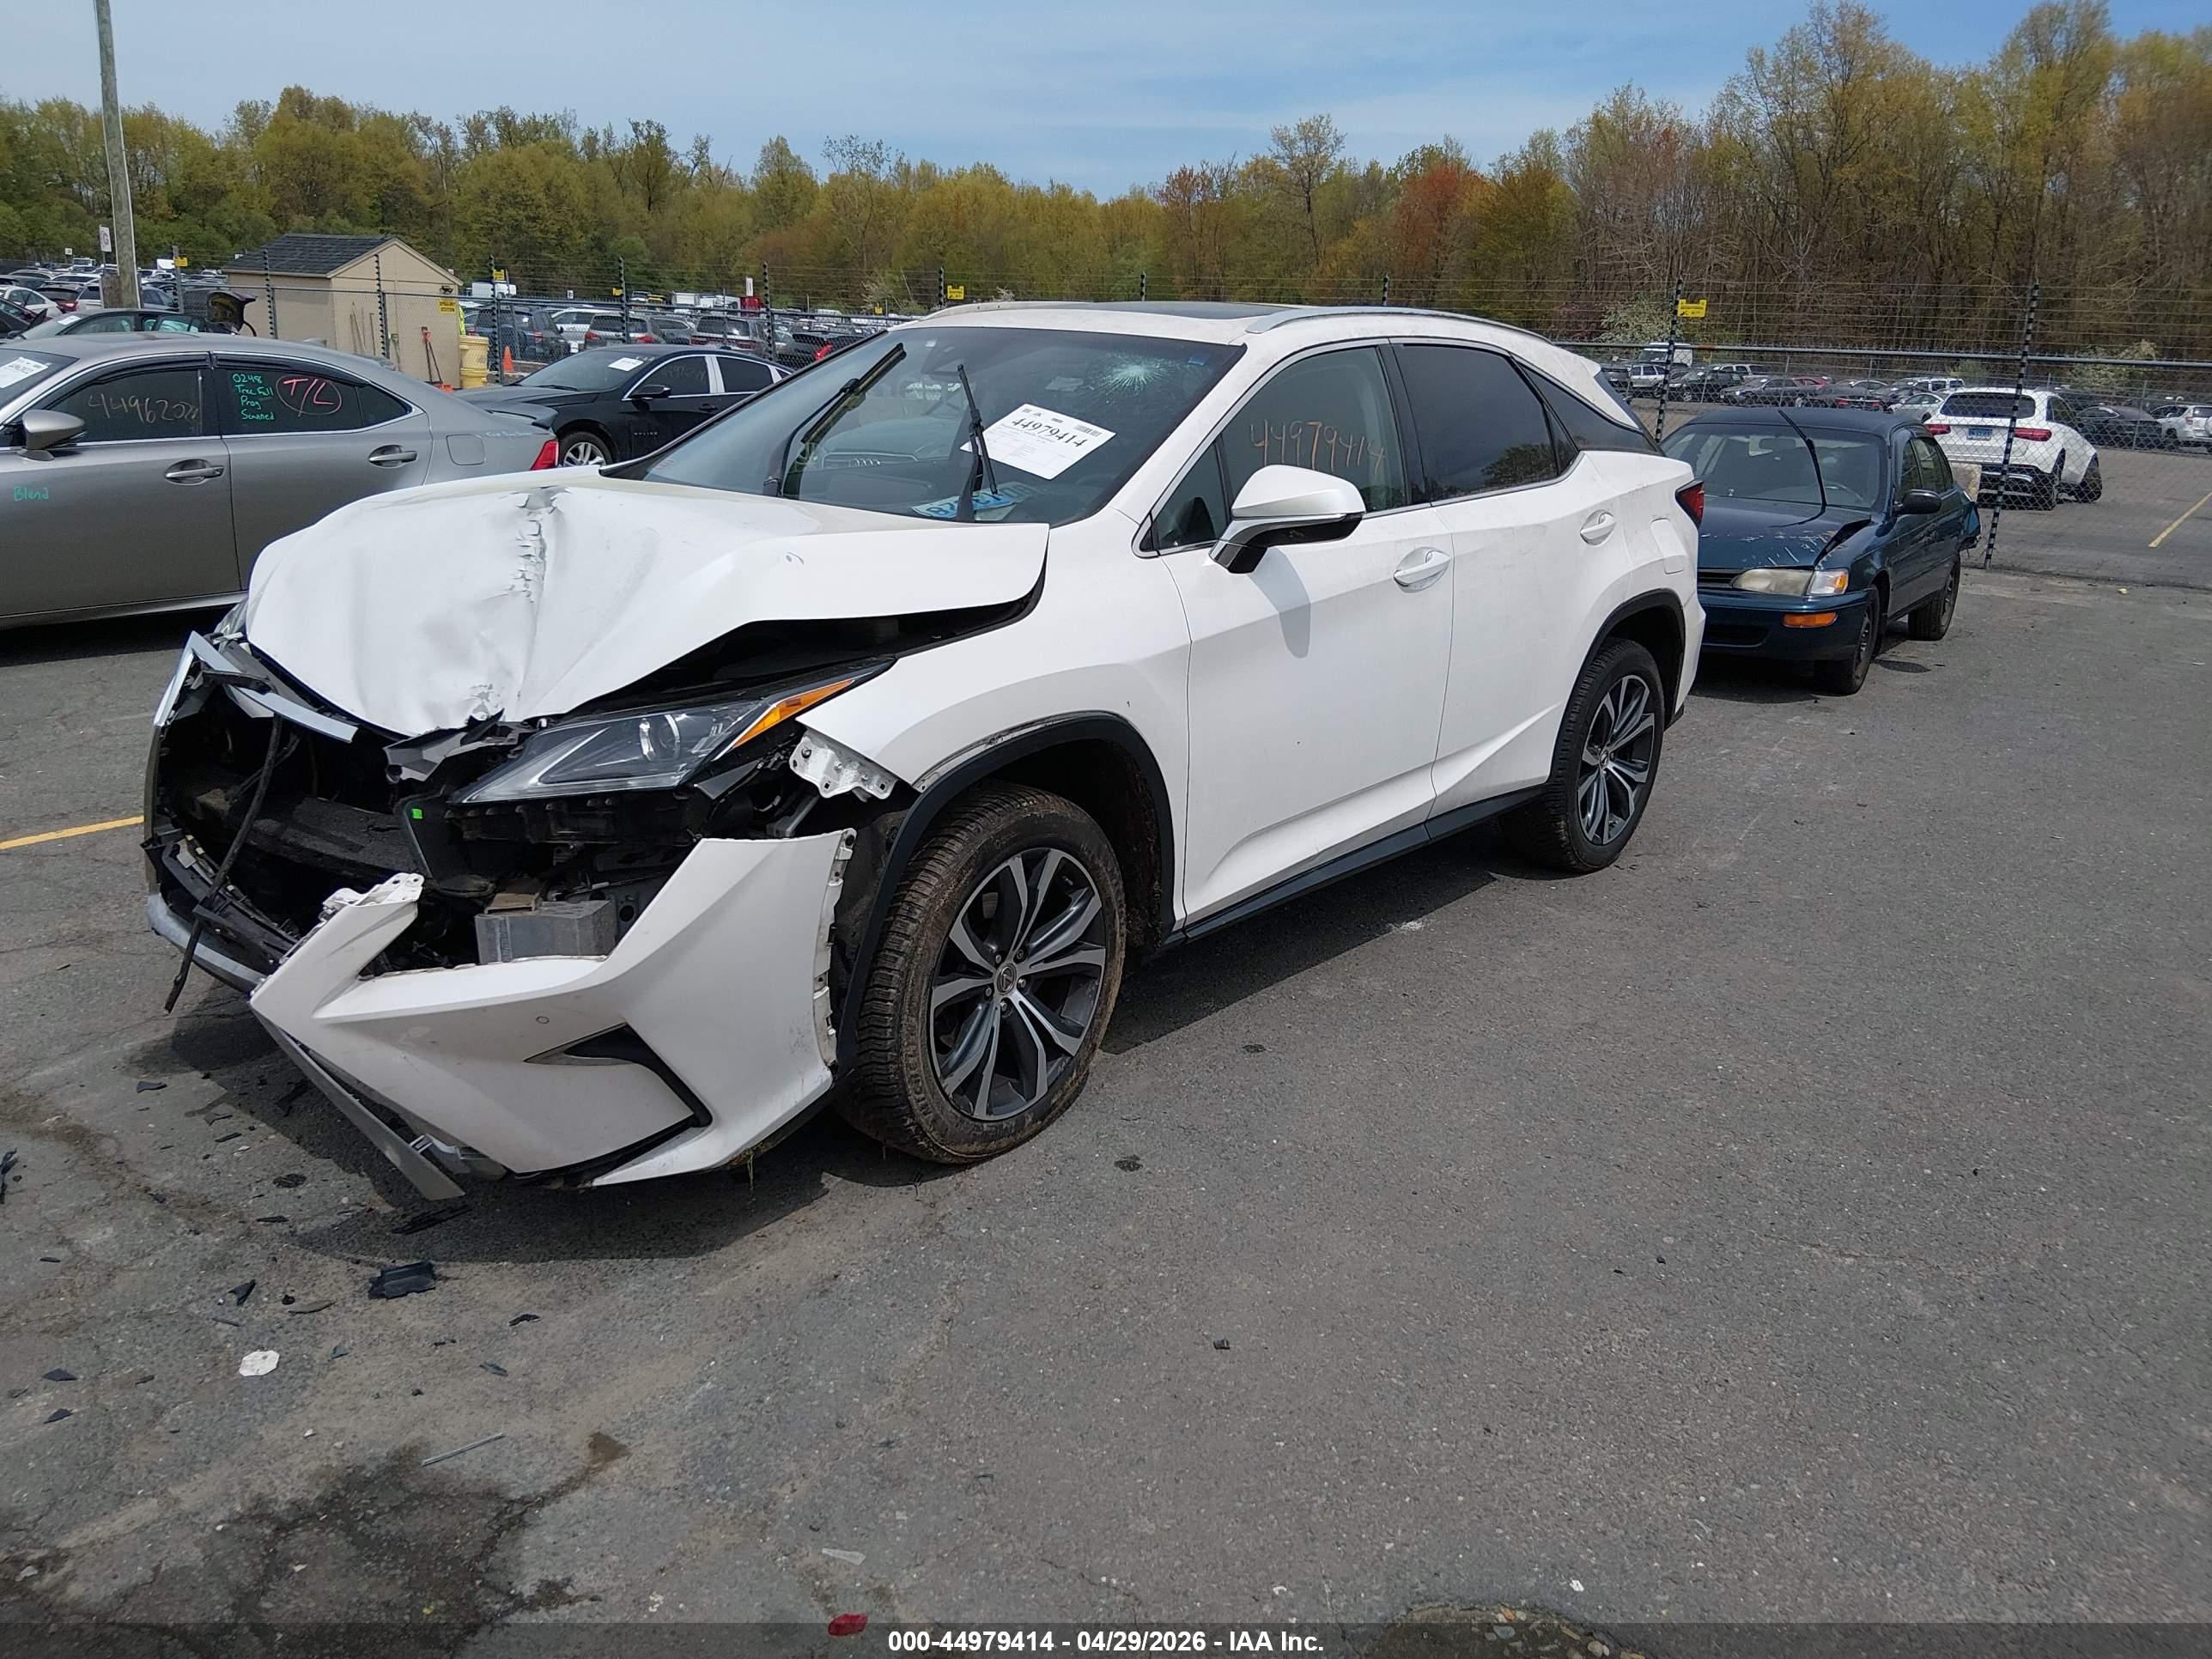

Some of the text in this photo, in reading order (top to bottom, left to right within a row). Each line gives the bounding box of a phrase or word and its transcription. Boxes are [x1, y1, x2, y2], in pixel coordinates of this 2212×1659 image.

[232, 374, 263, 384] 0248
[283, 378, 335, 417] T/L
[1012, 417, 1089, 447] 44979414
[1250, 419, 1385, 475] 44979414
